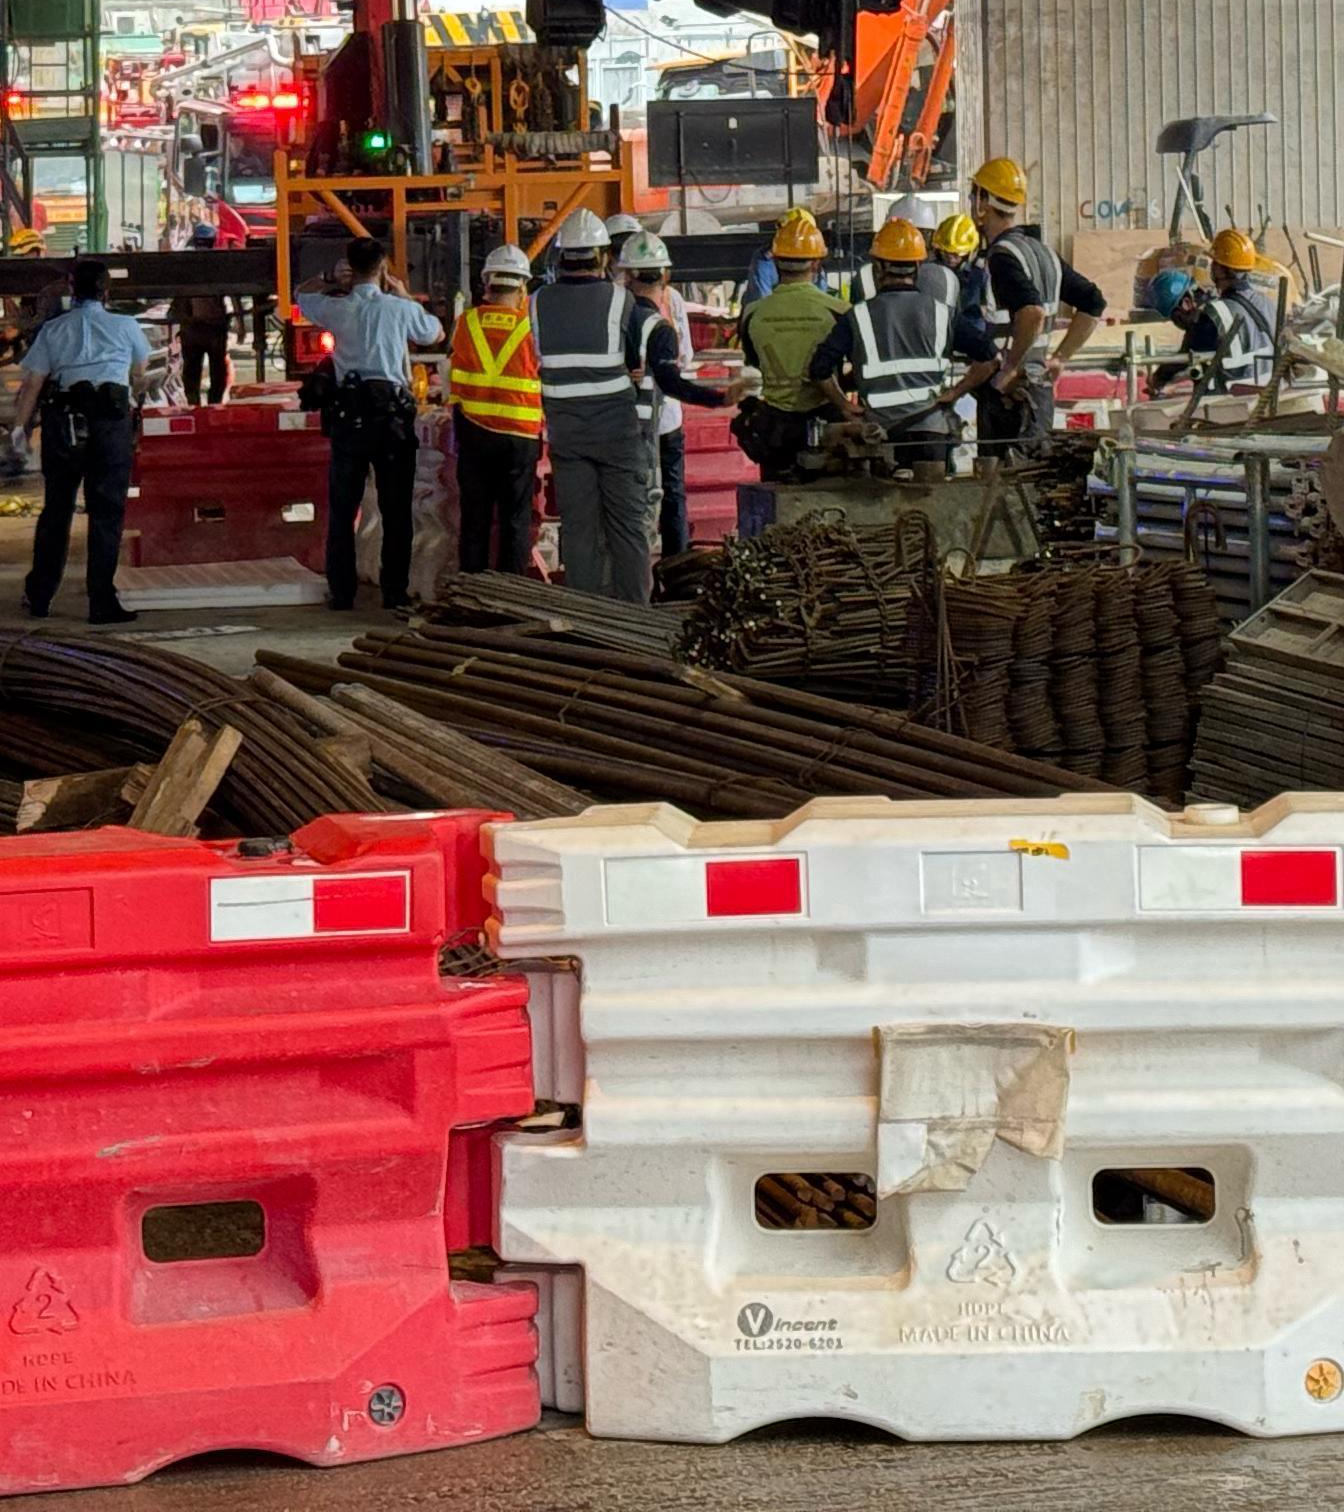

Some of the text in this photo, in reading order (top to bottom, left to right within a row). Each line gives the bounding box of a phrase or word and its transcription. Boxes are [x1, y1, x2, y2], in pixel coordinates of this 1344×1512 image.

[35, 1294, 55, 1319] 2
[737, 1302, 838, 1338] Vincent
[898, 1324, 958, 1344] MADE
[967, 1324, 993, 1343] IN
[34, 1375, 57, 1393] IN
[65, 1369, 138, 1390] CHINA
